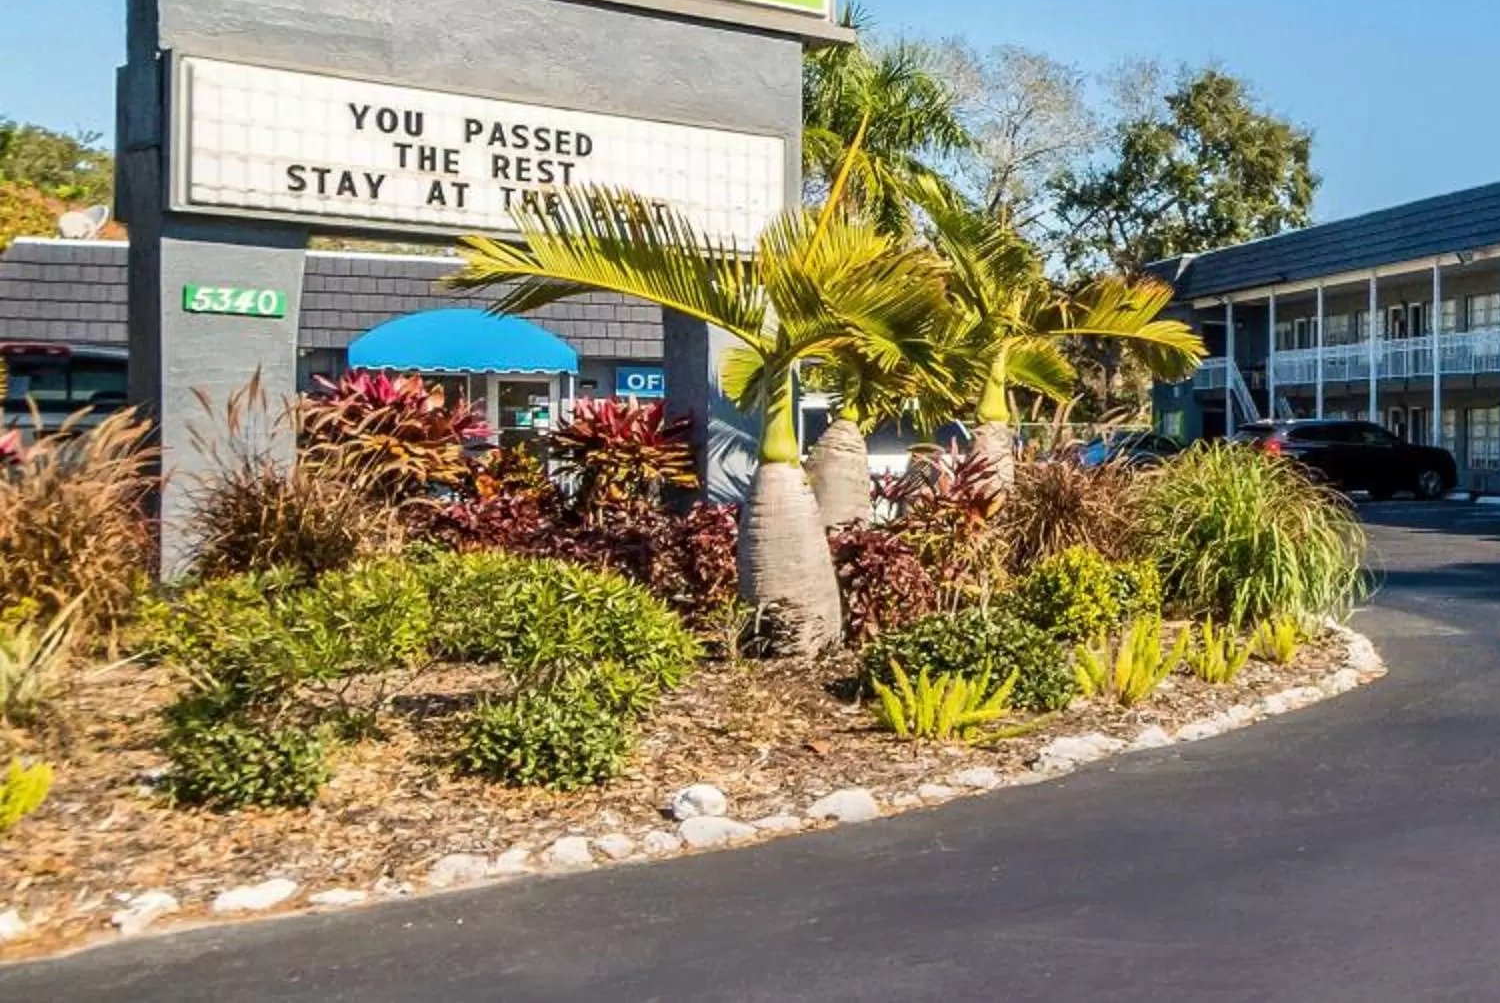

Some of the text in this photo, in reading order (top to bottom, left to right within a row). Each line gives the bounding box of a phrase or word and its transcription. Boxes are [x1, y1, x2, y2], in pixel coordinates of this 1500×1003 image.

[348, 102, 593, 158] YOU PASSED
[393, 141, 575, 186] THE REST
[286, 164, 387, 200] STAY
[426, 179, 470, 208] AT
[191, 286, 277, 315] 5340
[626, 374, 665, 390] OF
